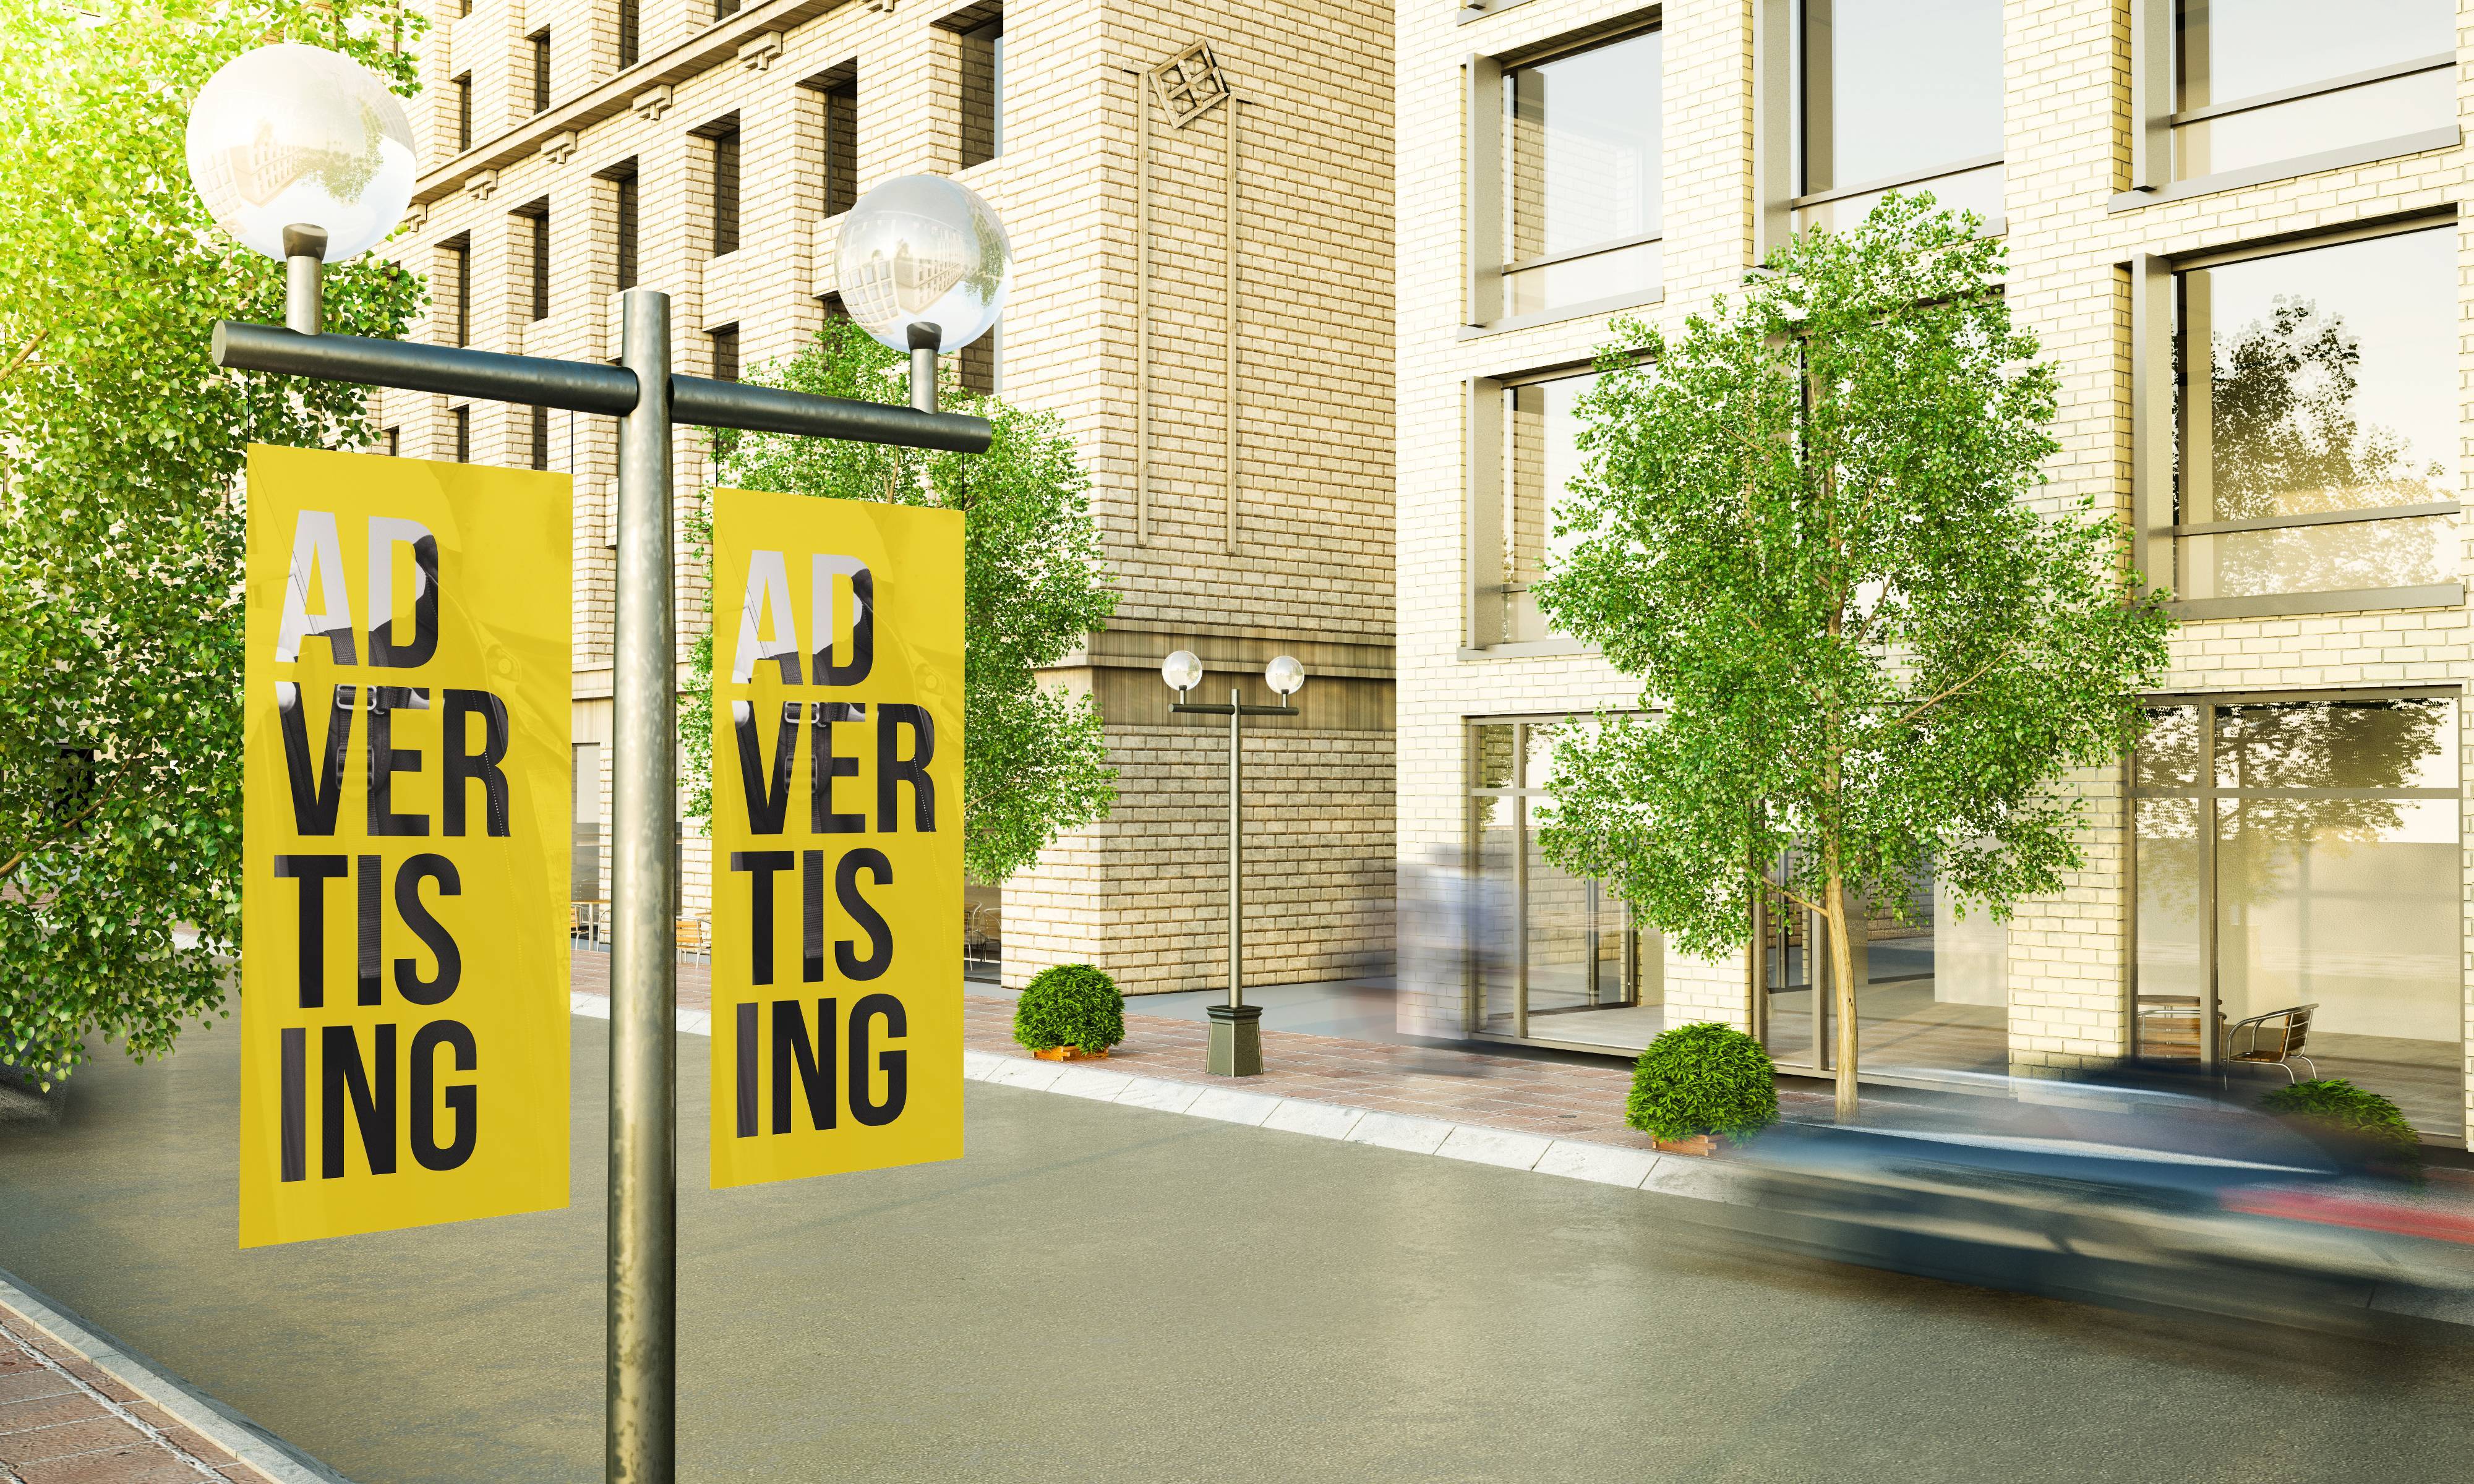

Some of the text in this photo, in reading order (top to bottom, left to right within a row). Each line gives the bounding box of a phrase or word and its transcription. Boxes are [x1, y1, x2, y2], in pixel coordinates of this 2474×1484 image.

[275, 509, 439, 668] AD
[731, 550, 873, 686] AD
[275, 681, 510, 837] VER
[731, 700, 936, 834] VER
[274, 854, 461, 1008] TIS
[730, 848, 893, 985] TIS
[281, 1020, 477, 1182] ING
[737, 994, 907, 1138] ING
